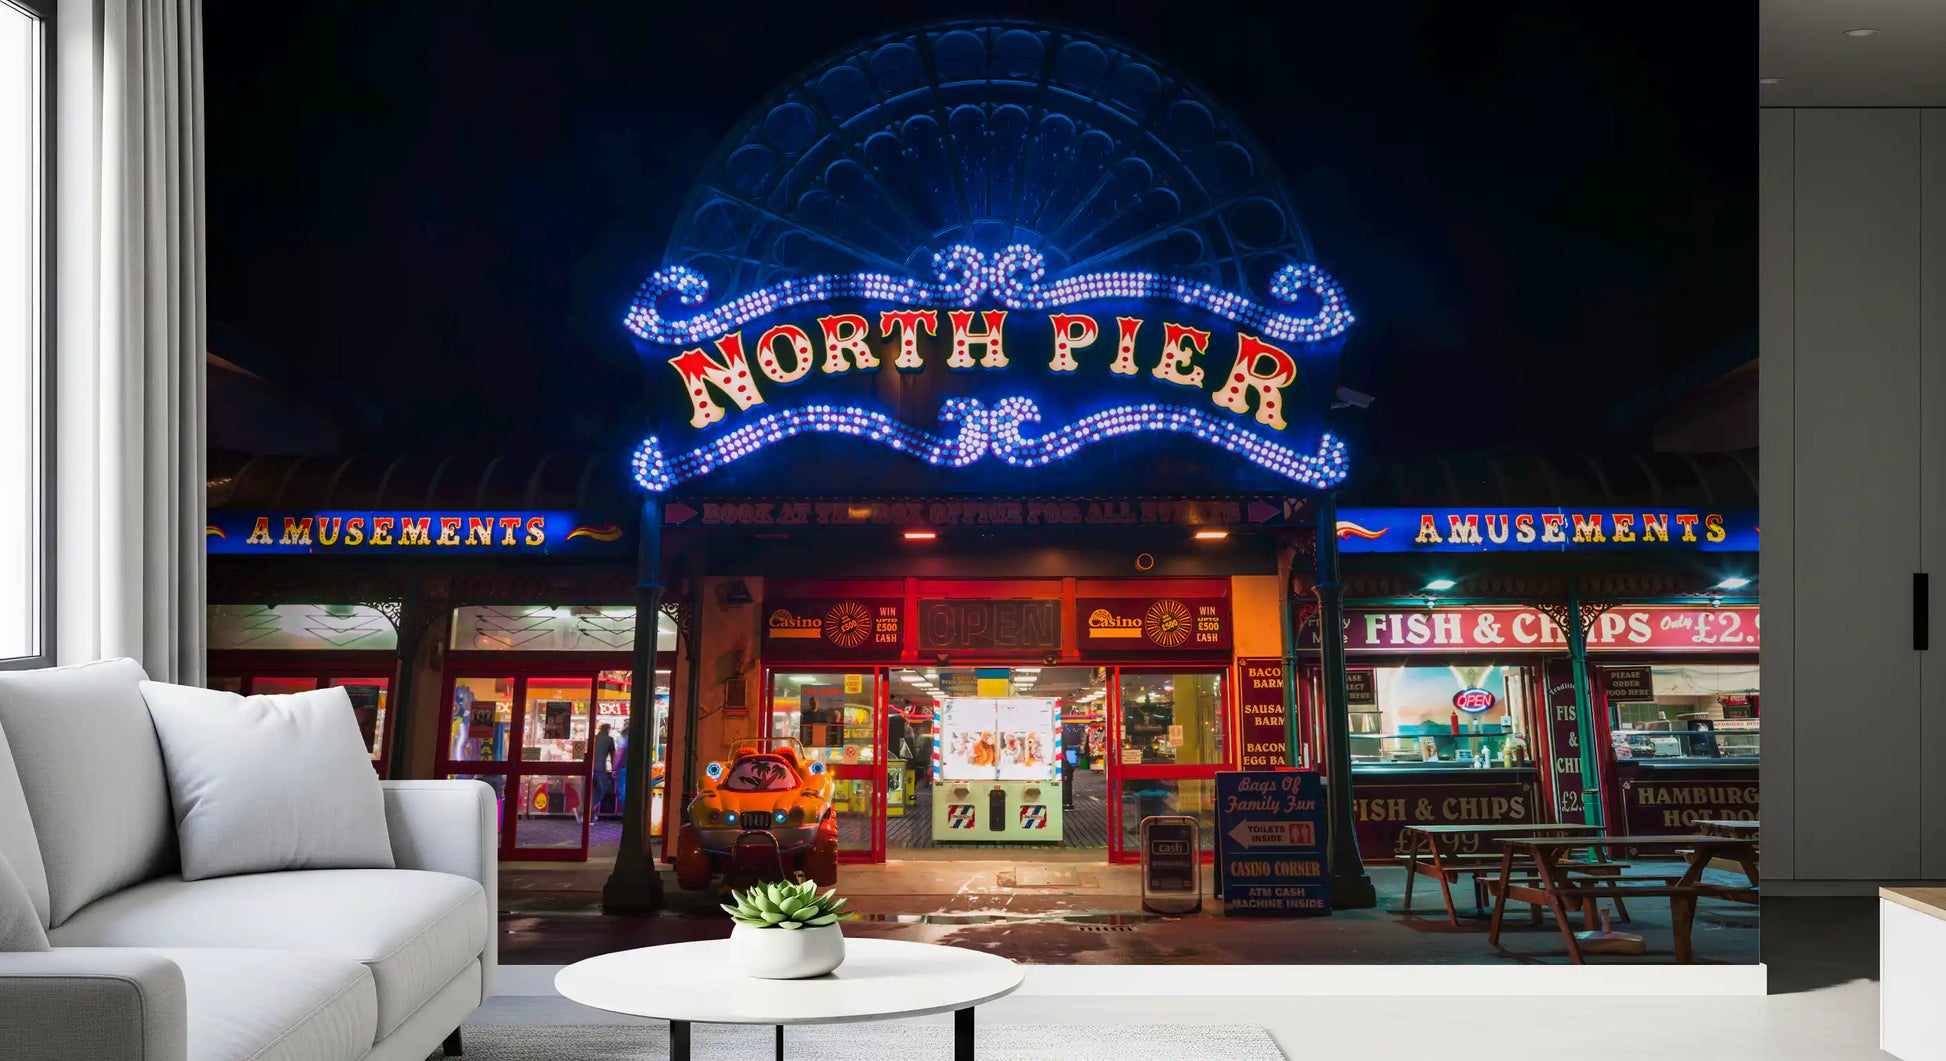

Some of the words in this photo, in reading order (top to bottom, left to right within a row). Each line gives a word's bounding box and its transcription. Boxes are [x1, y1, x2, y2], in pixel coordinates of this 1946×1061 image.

[667, 309, 1010, 430] NORTH
[1048, 312, 1298, 431] PIER
[701, 502, 775, 525] BOOK
[777, 502, 812, 525] AT
[929, 502, 1023, 524] OFFICE
[1026, 501, 1082, 524] FOR
[1084, 501, 1137, 523] ALL
[246, 515, 546, 547] AMUSEMENTS
[1414, 512, 1727, 545] AMUSEMENTS
[879, 606, 897, 617] WIN
[1199, 606, 1216, 616] WIN
[769, 611, 823, 628] Casino
[927, 602, 1054, 647] OPEN
[1089, 610, 1143, 628] Casino
[876, 623, 898, 632] £500
[1198, 622, 1220, 632] £500
[1364, 613, 1464, 644] FISH
[1472, 613, 1505, 643] &
[1660, 614, 1693, 631] Only
[875, 633, 898, 643] CASH
[1196, 633, 1218, 643] CASH
[1248, 667, 1284, 678] BACO
[1610, 671, 1641, 679] PLEASE
[1457, 694, 1492, 707] OPEN
[1244, 704, 1298, 714] SAUSA
[1556, 705, 1578, 721] FIS
[1568, 731, 1579, 748] &
[1246, 742, 1286, 753] BACON
[1243, 756, 1267, 766] EGG
[1237, 776, 1277, 795] Bags
[1281, 775, 1302, 795] Of
[1561, 790, 1585, 813] £2.
[1637, 786, 1759, 804] HAMBURG
[1224, 795, 1281, 815] Family
[1283, 795, 1316, 813] Fun
[1414, 797, 1435, 821] &
[1442, 795, 1526, 821] CHIPS
[1247, 825, 1286, 834] TOILETS
[1251, 834, 1283, 843] INSIDE
[1159, 841, 1183, 853] cash
[1230, 860, 1271, 877] CASINO
[1274, 860, 1321, 877] CORNER
[1248, 887, 1273, 897] ATM
[1275, 887, 1306, 897] CASH
[1231, 898, 1283, 909] MACHINE
[1286, 898, 1324, 909] INSIDE
